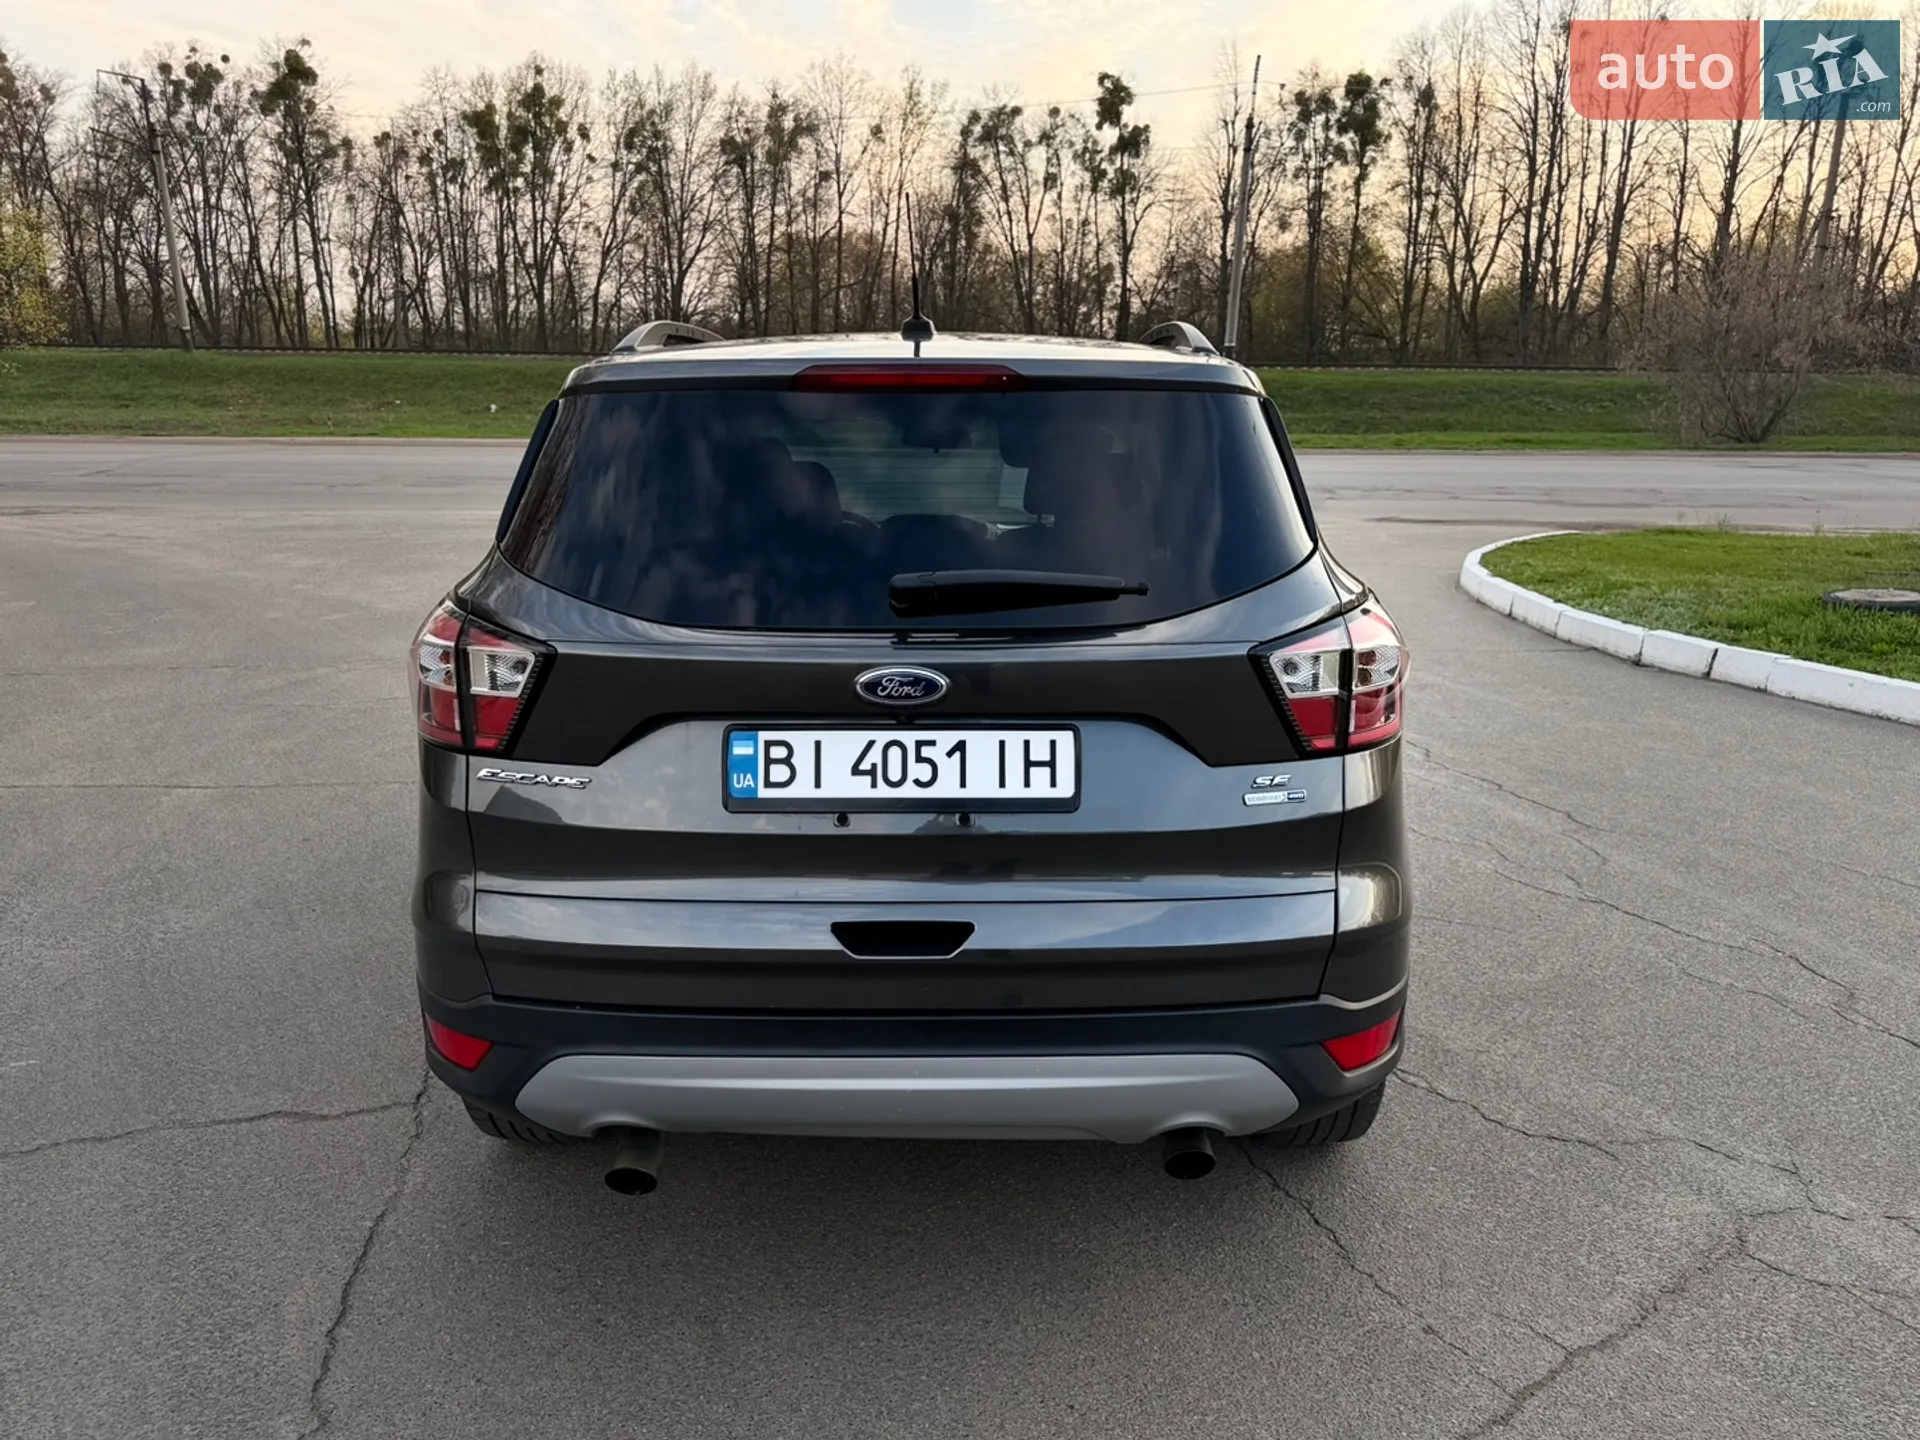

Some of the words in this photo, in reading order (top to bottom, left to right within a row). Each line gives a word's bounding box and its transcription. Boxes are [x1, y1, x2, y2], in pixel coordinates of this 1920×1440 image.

[877, 676, 926, 697] Ford
[763, 739, 822, 789] BI
[850, 739, 967, 789] 4051
[998, 739, 1058, 789] IH
[733, 773, 755, 788] UA
